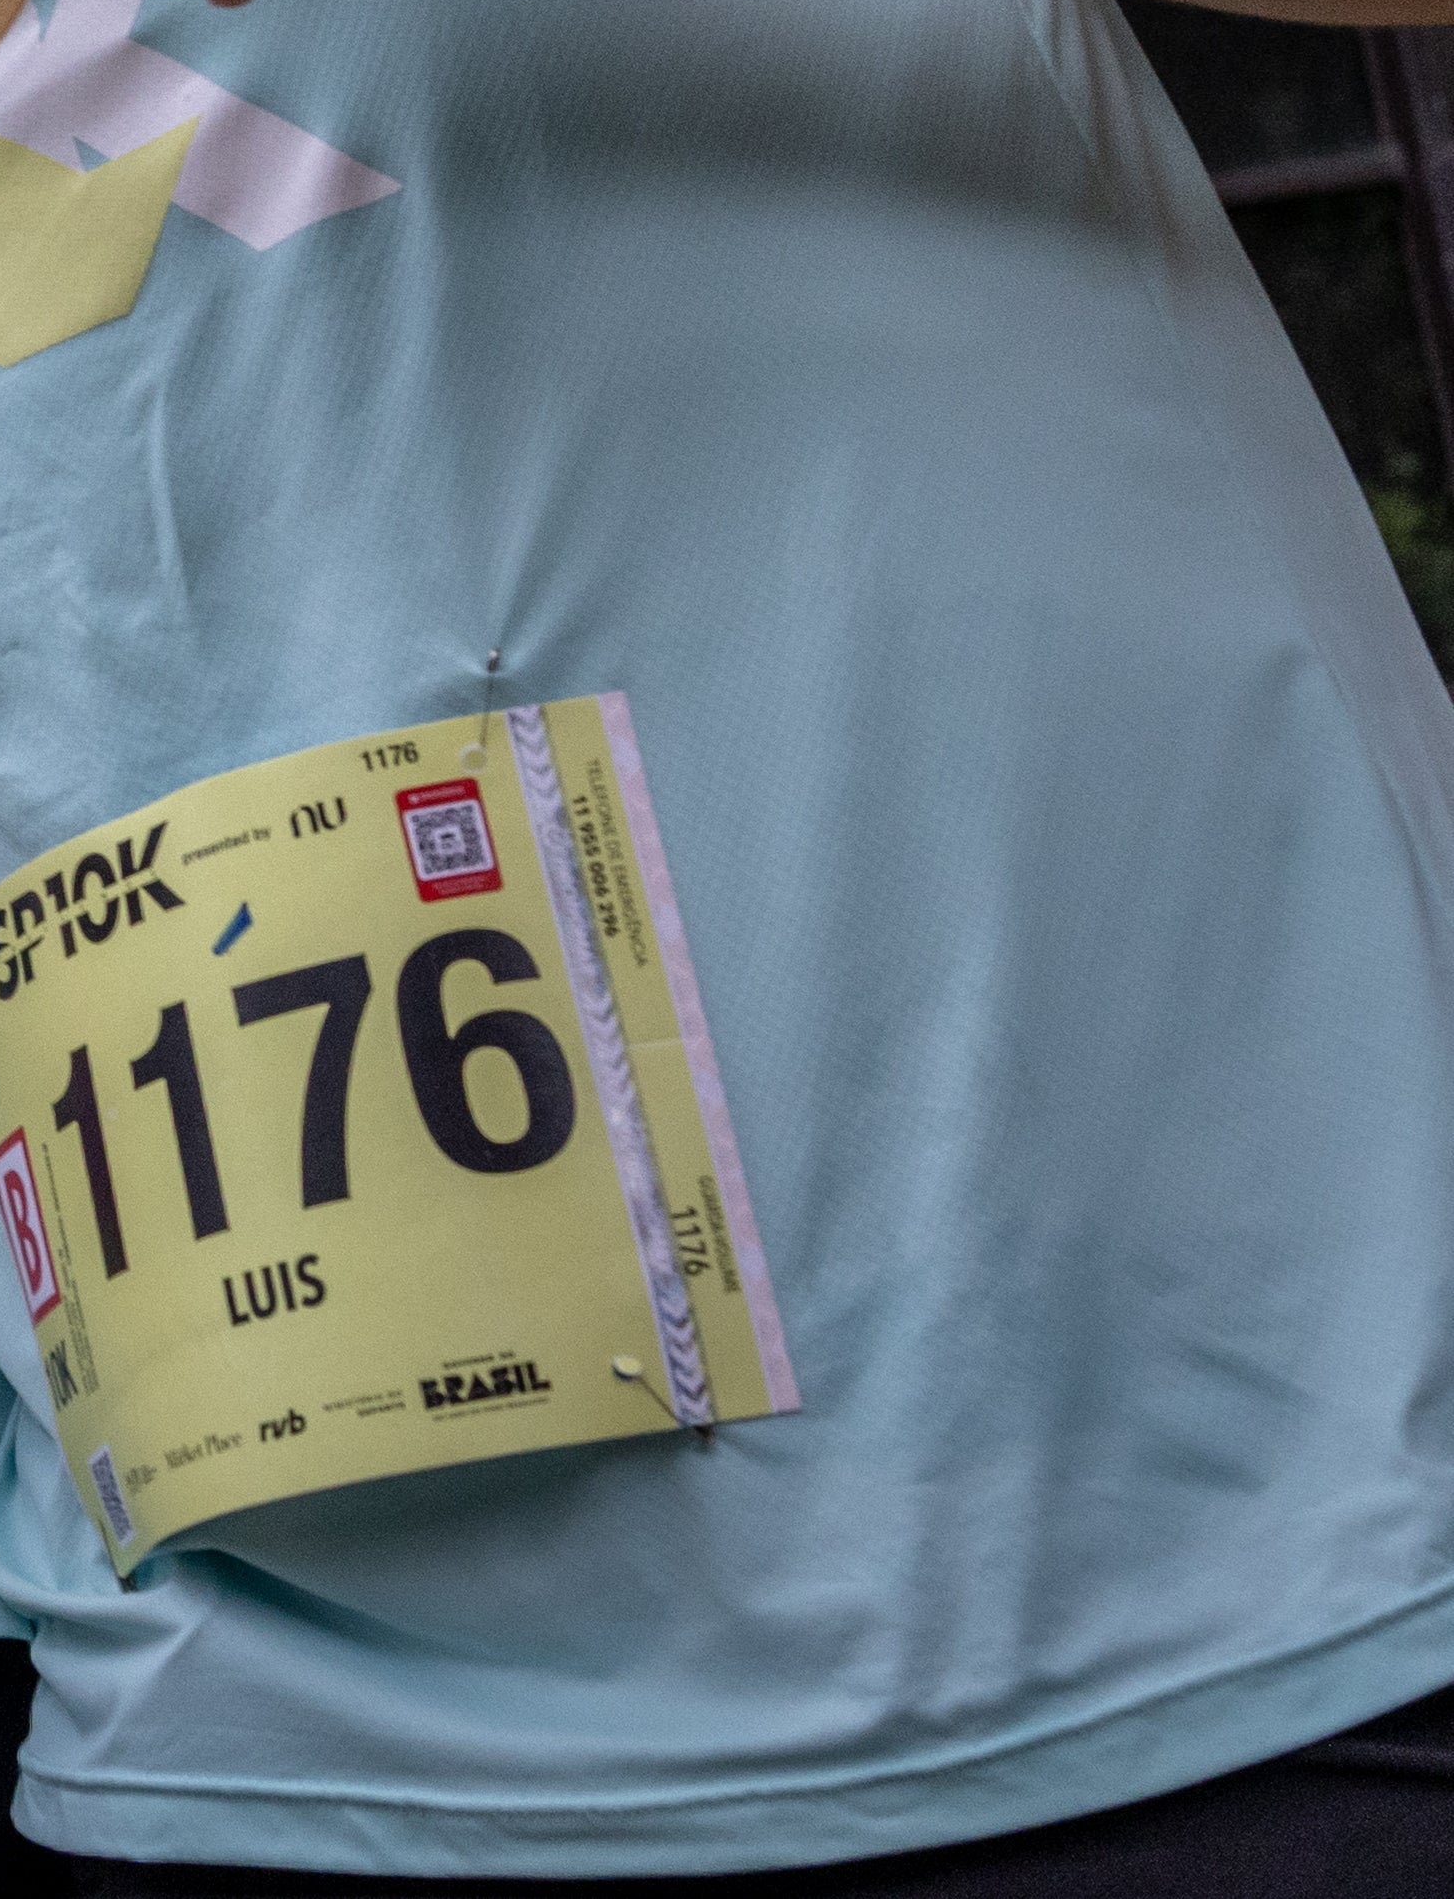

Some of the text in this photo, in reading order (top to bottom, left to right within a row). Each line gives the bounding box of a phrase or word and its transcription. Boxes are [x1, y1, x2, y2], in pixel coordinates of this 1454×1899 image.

[360, 741, 422, 773] 1176
[289, 797, 348, 840] nu
[52, 927, 576, 1281] 1176
[3, 1169, 42, 1296] B
[669, 1203, 709, 1279] 1176
[222, 1252, 328, 1328] LUIS
[418, 1360, 553, 1410] BRASIL
[257, 1408, 308, 1444] rvb
